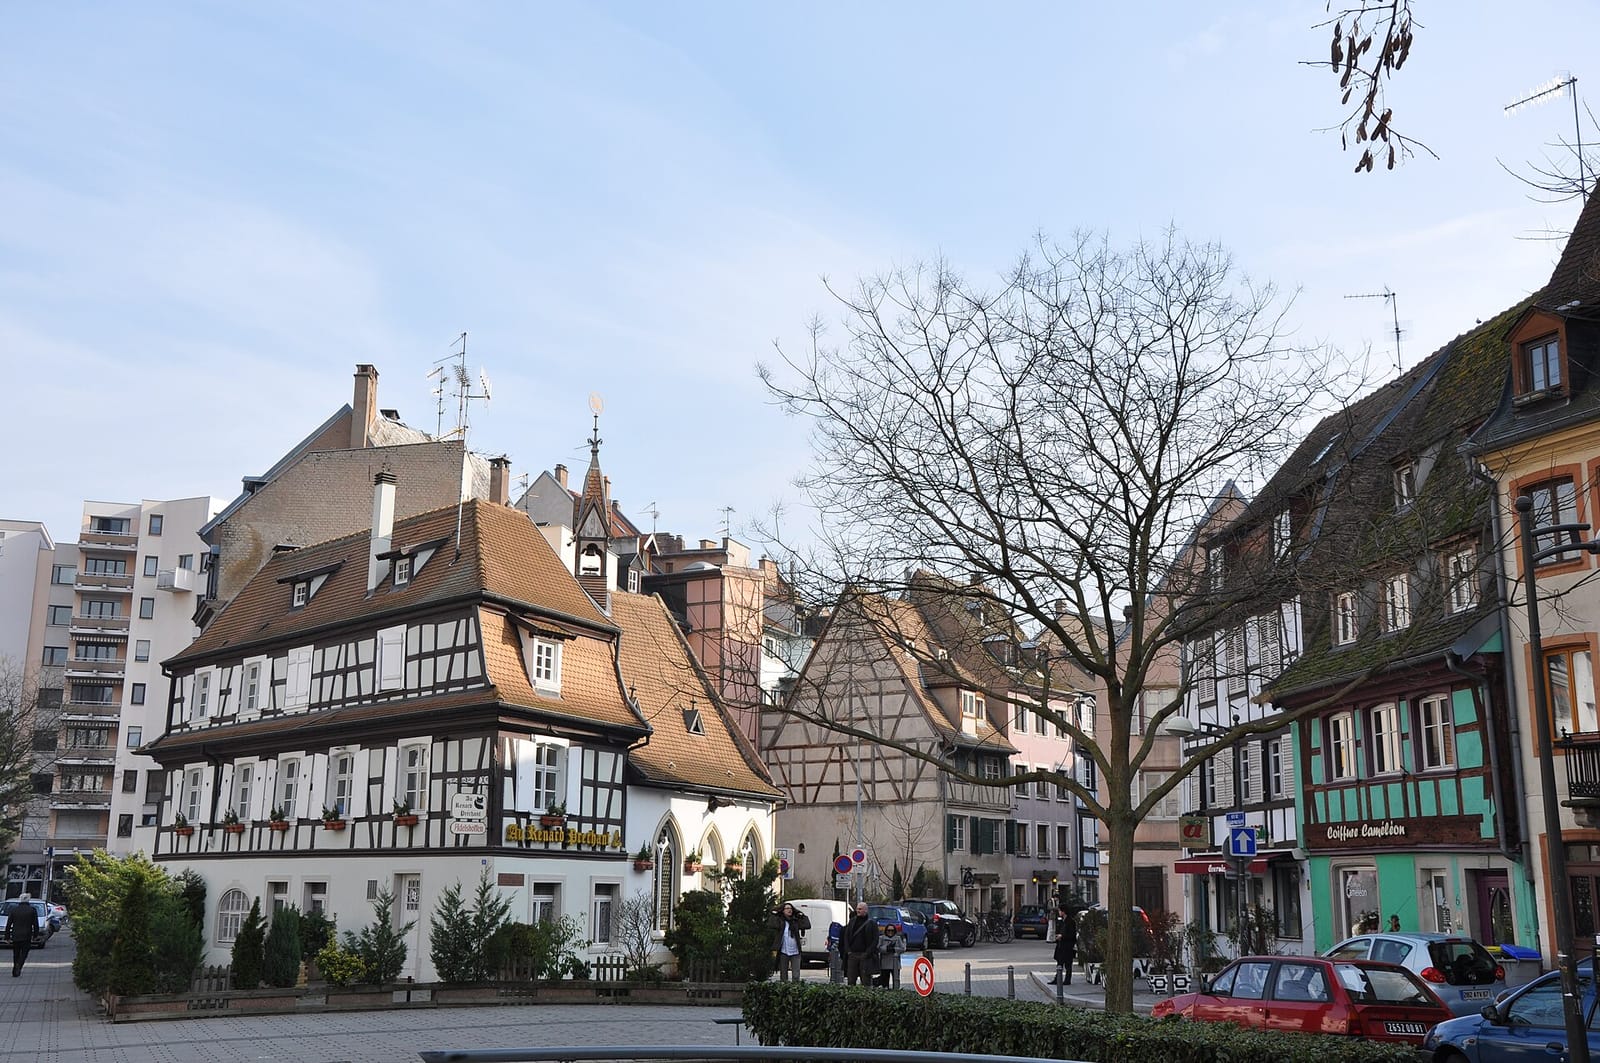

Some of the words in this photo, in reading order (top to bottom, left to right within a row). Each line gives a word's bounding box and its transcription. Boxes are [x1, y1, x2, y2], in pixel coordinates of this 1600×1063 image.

[506, 823, 525, 841] Au
[526, 825, 565, 842] Renard
[1327, 825, 1359, 841] Coiffure
[1361, 820, 1405, 838] Caméléon
